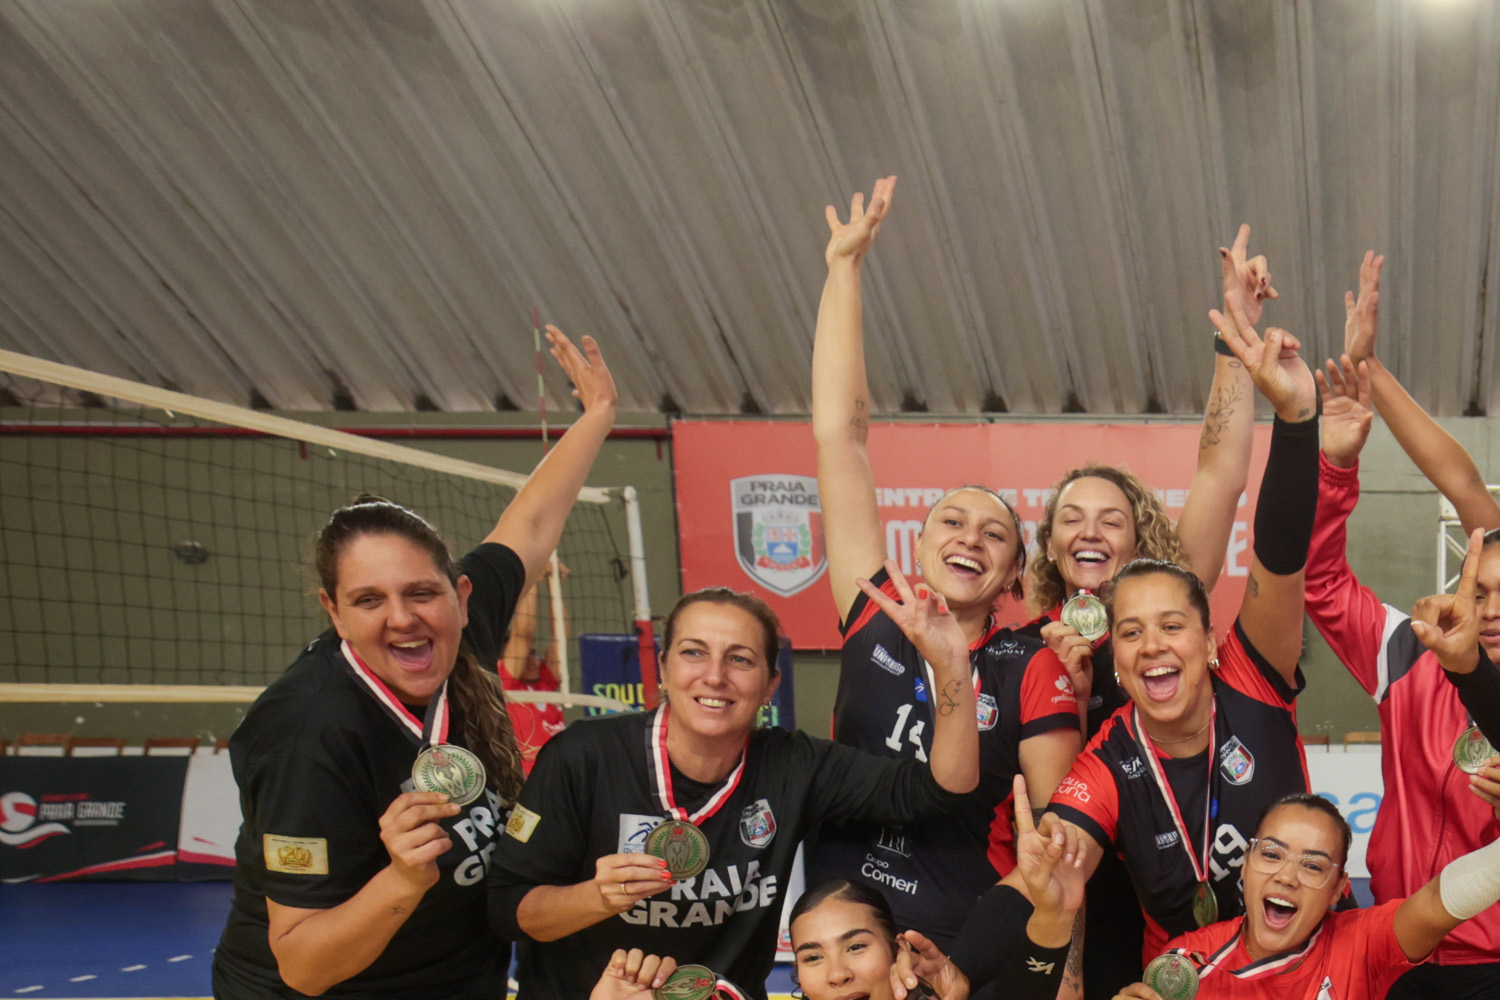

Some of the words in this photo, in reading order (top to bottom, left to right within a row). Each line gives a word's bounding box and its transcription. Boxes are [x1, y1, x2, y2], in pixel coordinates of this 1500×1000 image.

[740, 493, 819, 507] GRANDE
[750, 481, 806, 493] PRAIA
[875, 488, 945, 507] ENTR
[646, 860, 761, 900] RAIA
[861, 862, 918, 895] Comeri
[619, 875, 777, 929] GRANDE
